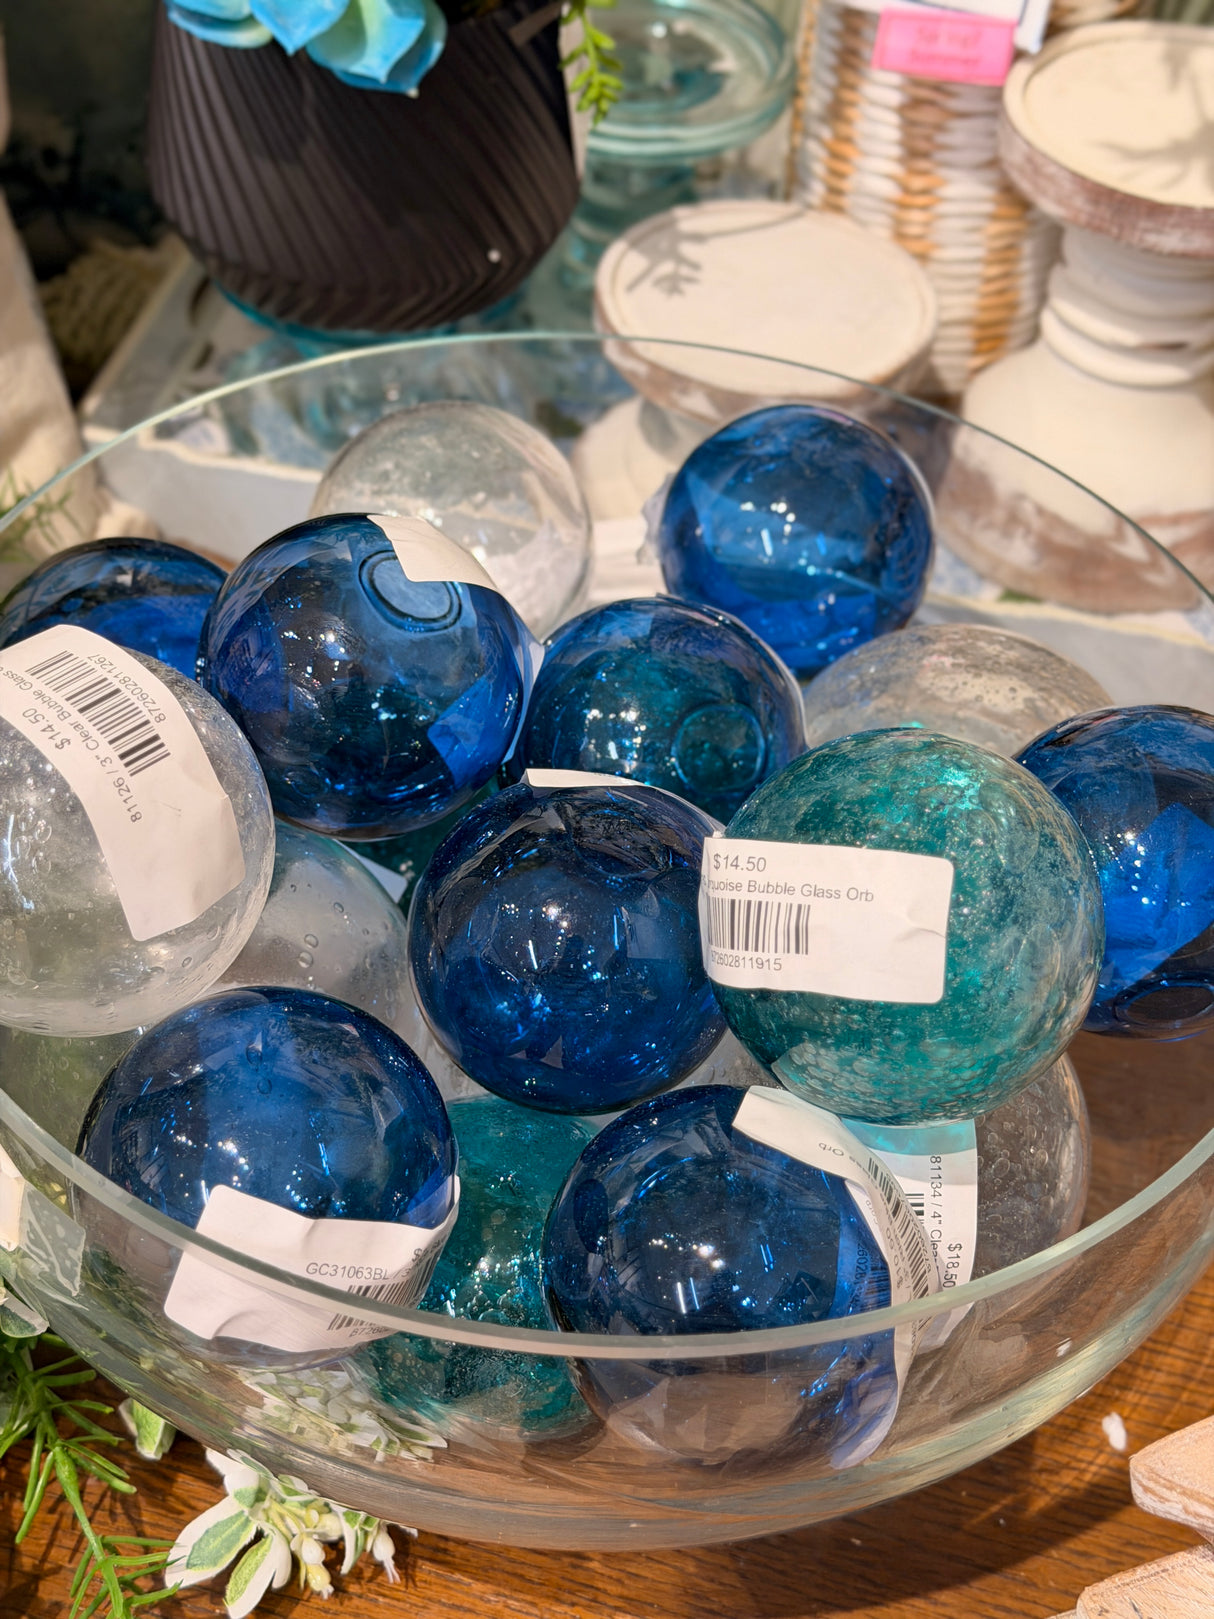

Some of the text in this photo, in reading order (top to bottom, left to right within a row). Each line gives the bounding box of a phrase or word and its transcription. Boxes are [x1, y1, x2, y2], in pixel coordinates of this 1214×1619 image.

[2, 670, 33, 691] Glass
[87, 653, 166, 724] 872602811267
[32, 688, 72, 722] Bubble
[22, 707, 71, 750] $14.50
[69, 721, 100, 751] Clear
[113, 777, 143, 823] 81126
[713, 853, 767, 872] $14.50
[747, 879, 796, 896] Bubble
[800, 883, 841, 899] Glass
[846, 887, 875, 902] Orb
[817, 1142, 845, 1157] Orb
[930, 1155, 942, 1199] 81134
[930, 1211, 942, 1225] 4"
[930, 1229, 942, 1262] Clea
[306, 1262, 389, 1281] GC31063BL
[942, 1243, 963, 1288] $18.50
